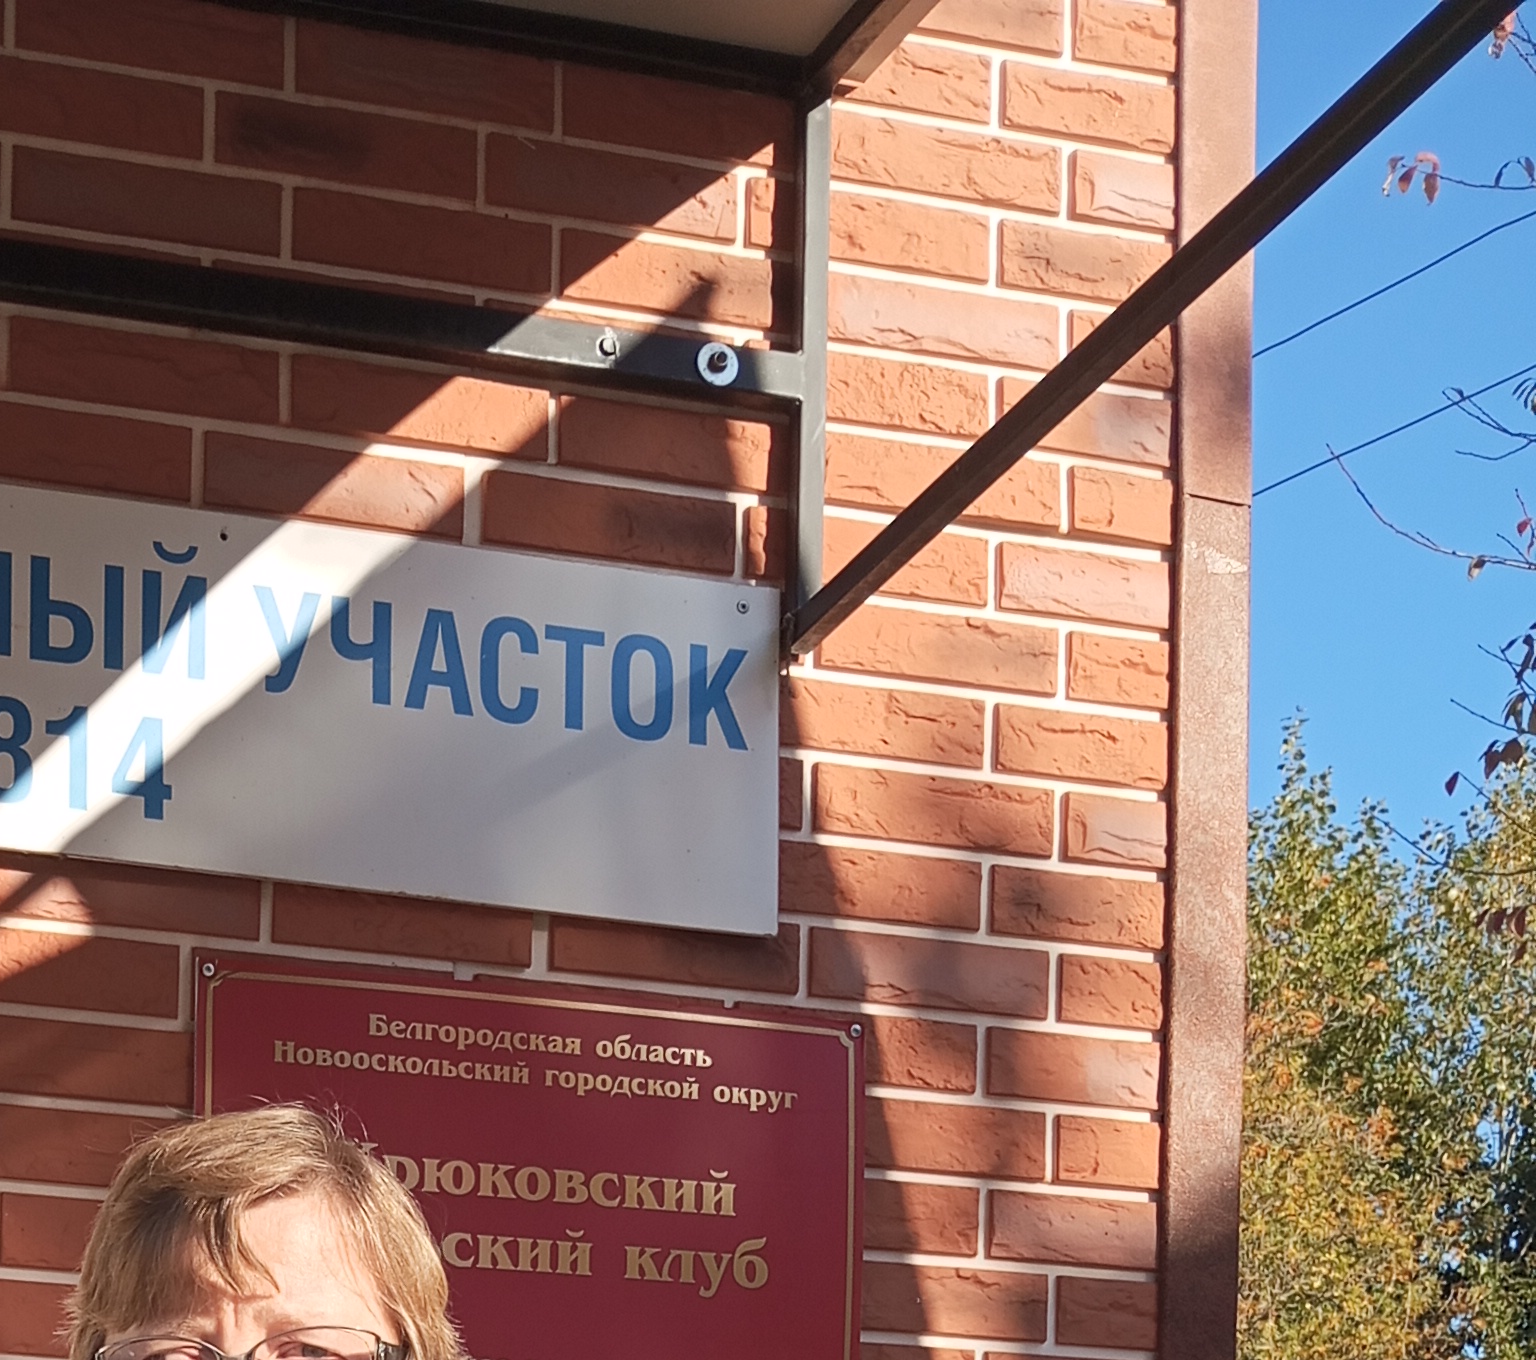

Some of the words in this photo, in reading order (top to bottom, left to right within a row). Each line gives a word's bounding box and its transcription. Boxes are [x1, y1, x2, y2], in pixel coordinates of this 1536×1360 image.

[252, 583, 750, 752] УЧАСТОК
[272, 1039, 530, 1087] Новооскольский
[545, 1068, 700, 1105] городской
[713, 1081, 798, 1114] округ
[368, 1012, 582, 1057] Белгородская
[595, 1034, 713, 1069] область
[360, 1142, 737, 1218] рюковский
[442, 1230, 593, 1278] ский
[624, 1237, 770, 1298] клуб
